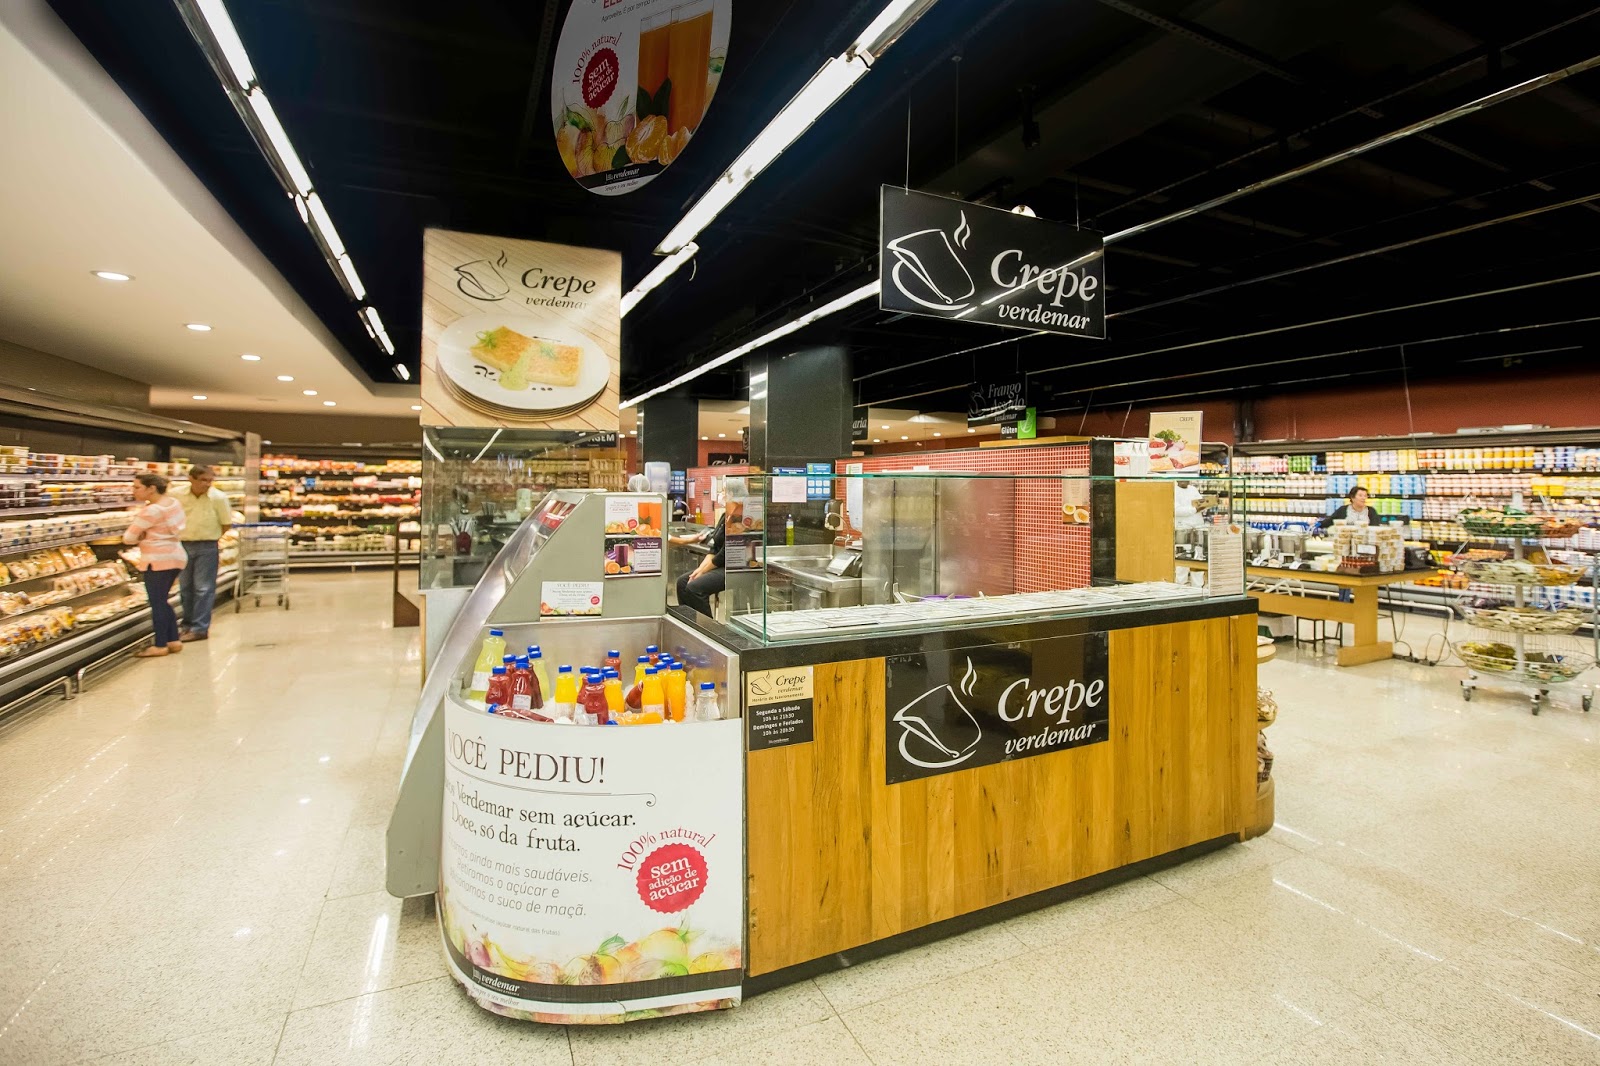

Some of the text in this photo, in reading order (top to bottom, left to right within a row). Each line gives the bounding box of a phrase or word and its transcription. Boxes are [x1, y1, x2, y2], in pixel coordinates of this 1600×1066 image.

[573, 47, 591, 84] 100%
[588, 58, 610, 83] sem
[520, 267, 596, 298] Crepe
[989, 249, 1099, 308] Crepe
[998, 303, 1091, 330] verdemar
[988, 382, 1022, 399] Frango
[775, 674, 806, 687] Crepe
[997, 678, 1105, 724] Crepe
[1005, 723, 1096, 755] verdemar
[499, 748, 604, 784] PEDIU!
[456, 781, 514, 819] Verdemar
[519, 809, 556, 825] sem
[563, 811, 636, 828] açúcar.
[452, 801, 581, 852] Doce, só da fruta.
[616, 825, 716, 873] 100% natural
[470, 851, 593, 883] ainda mais saudáveis.
[648, 869, 697, 890] adição de
[651, 857, 691, 879] sem
[497, 880, 503, 889] o
[506, 881, 548, 897] açúcar
[551, 887, 560, 899] e
[649, 877, 700, 901] açúcar
[488, 893, 495, 903] o
[497, 895, 522, 911] suco
[526, 900, 541, 914] de
[545, 903, 587, 919] maçã.
[481, 975, 520, 992] verdemar
